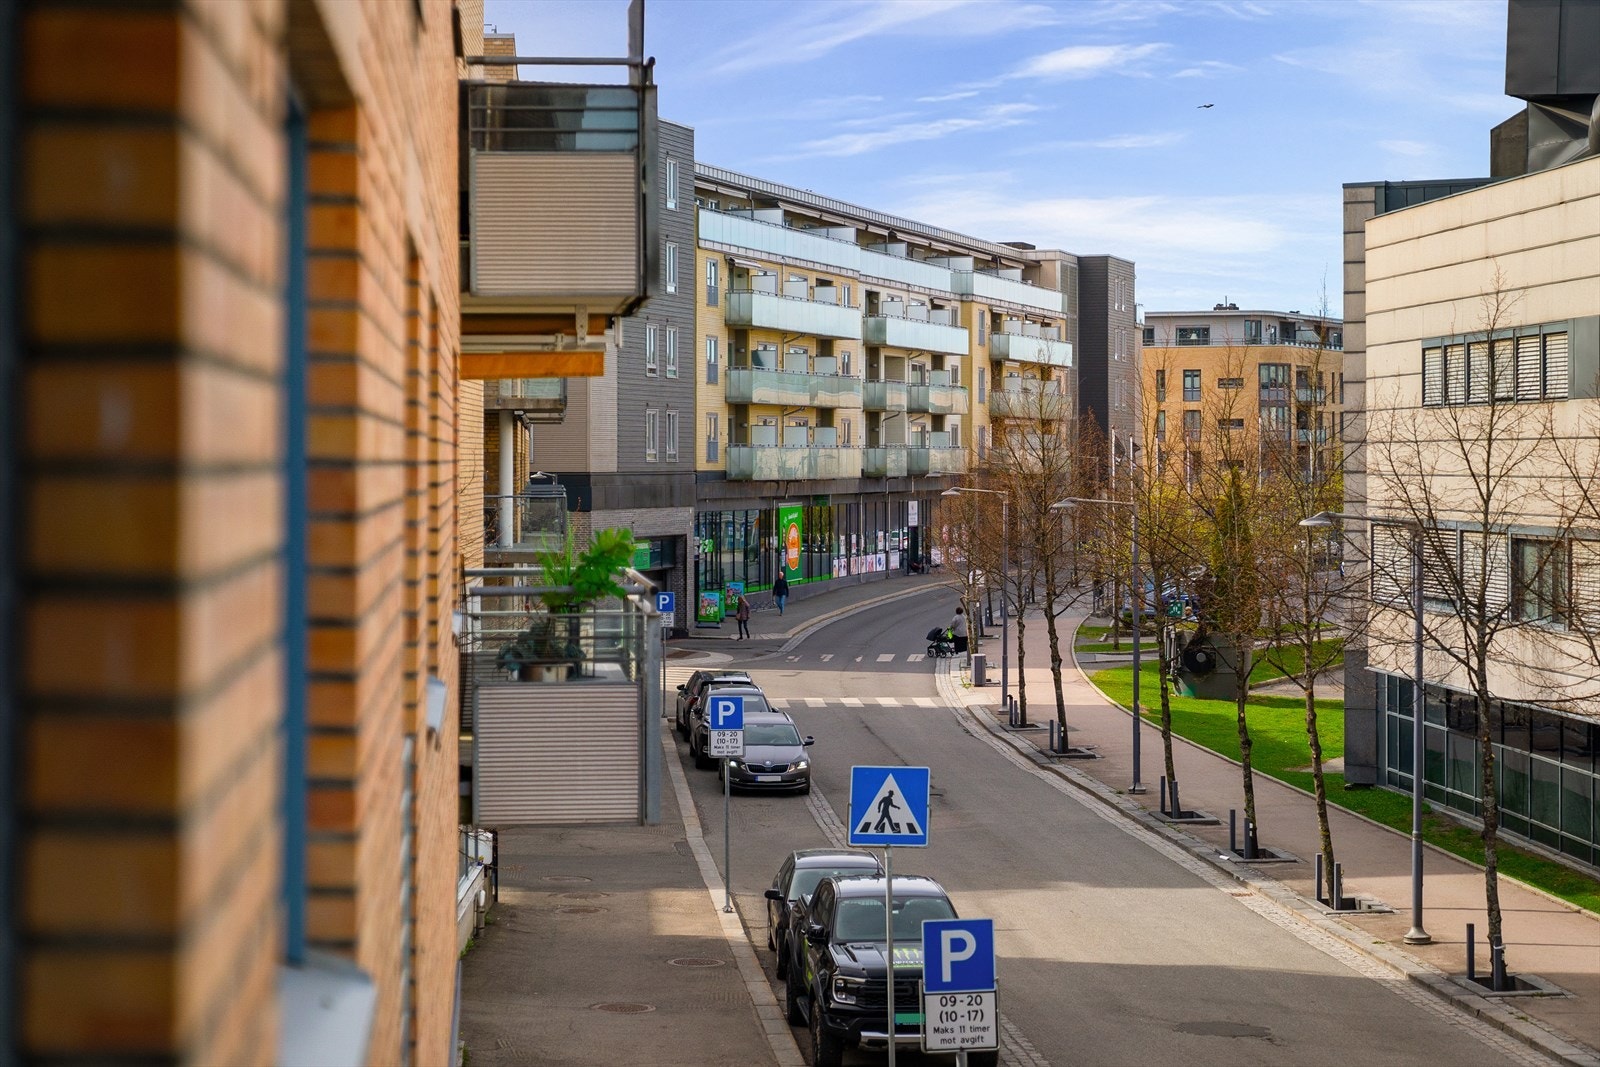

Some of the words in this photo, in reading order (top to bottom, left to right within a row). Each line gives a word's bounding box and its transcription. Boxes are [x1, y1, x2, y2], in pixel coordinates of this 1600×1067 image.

[659, 594, 669, 609] P
[718, 701, 735, 725] P
[941, 929, 976, 982] P
[933, 1026, 954, 1034] Maks
[959, 1025, 966, 1033] 11
[969, 1025, 990, 1033] timer
[960, 1036, 984, 1045] avgift
